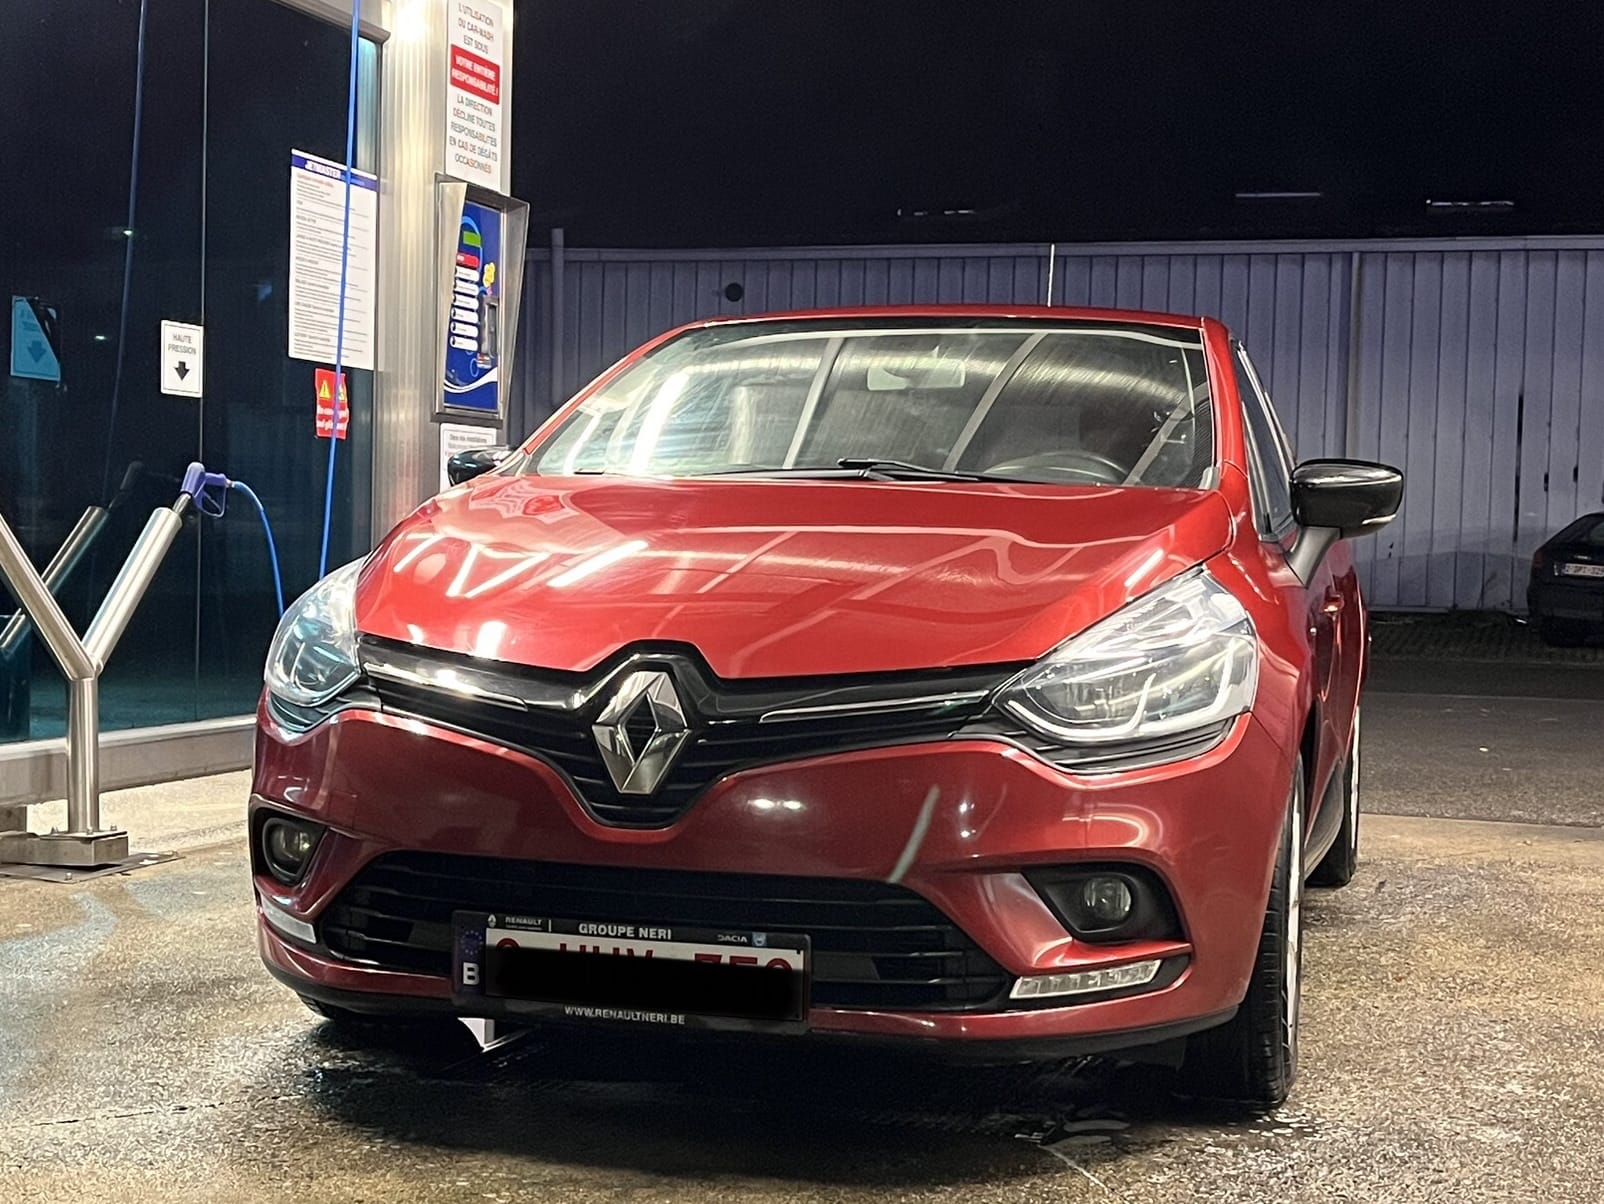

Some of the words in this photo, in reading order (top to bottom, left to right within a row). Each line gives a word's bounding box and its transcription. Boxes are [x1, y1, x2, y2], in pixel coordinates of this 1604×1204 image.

[463, 35, 474, 46] EST
[474, 40, 488, 54] SOUS
[457, 94, 464, 104] LA
[465, 97, 493, 116] DIRECTION
[476, 116, 496, 132] TOUTES
[449, 136, 456, 146] EN
[458, 139, 468, 151] CAS
[469, 144, 477, 154] DE
[172, 332, 192, 344] HAUTE
[168, 343, 197, 355] PRESSION
[505, 916, 542, 926] RENAULT
[578, 923, 635, 937] GROUPE
[638, 927, 672, 940] NERI
[717, 934, 748, 943] DACIA
[463, 962, 480, 985] B
[564, 1006, 685, 1025] WWW.RENAULTNERI.BE
